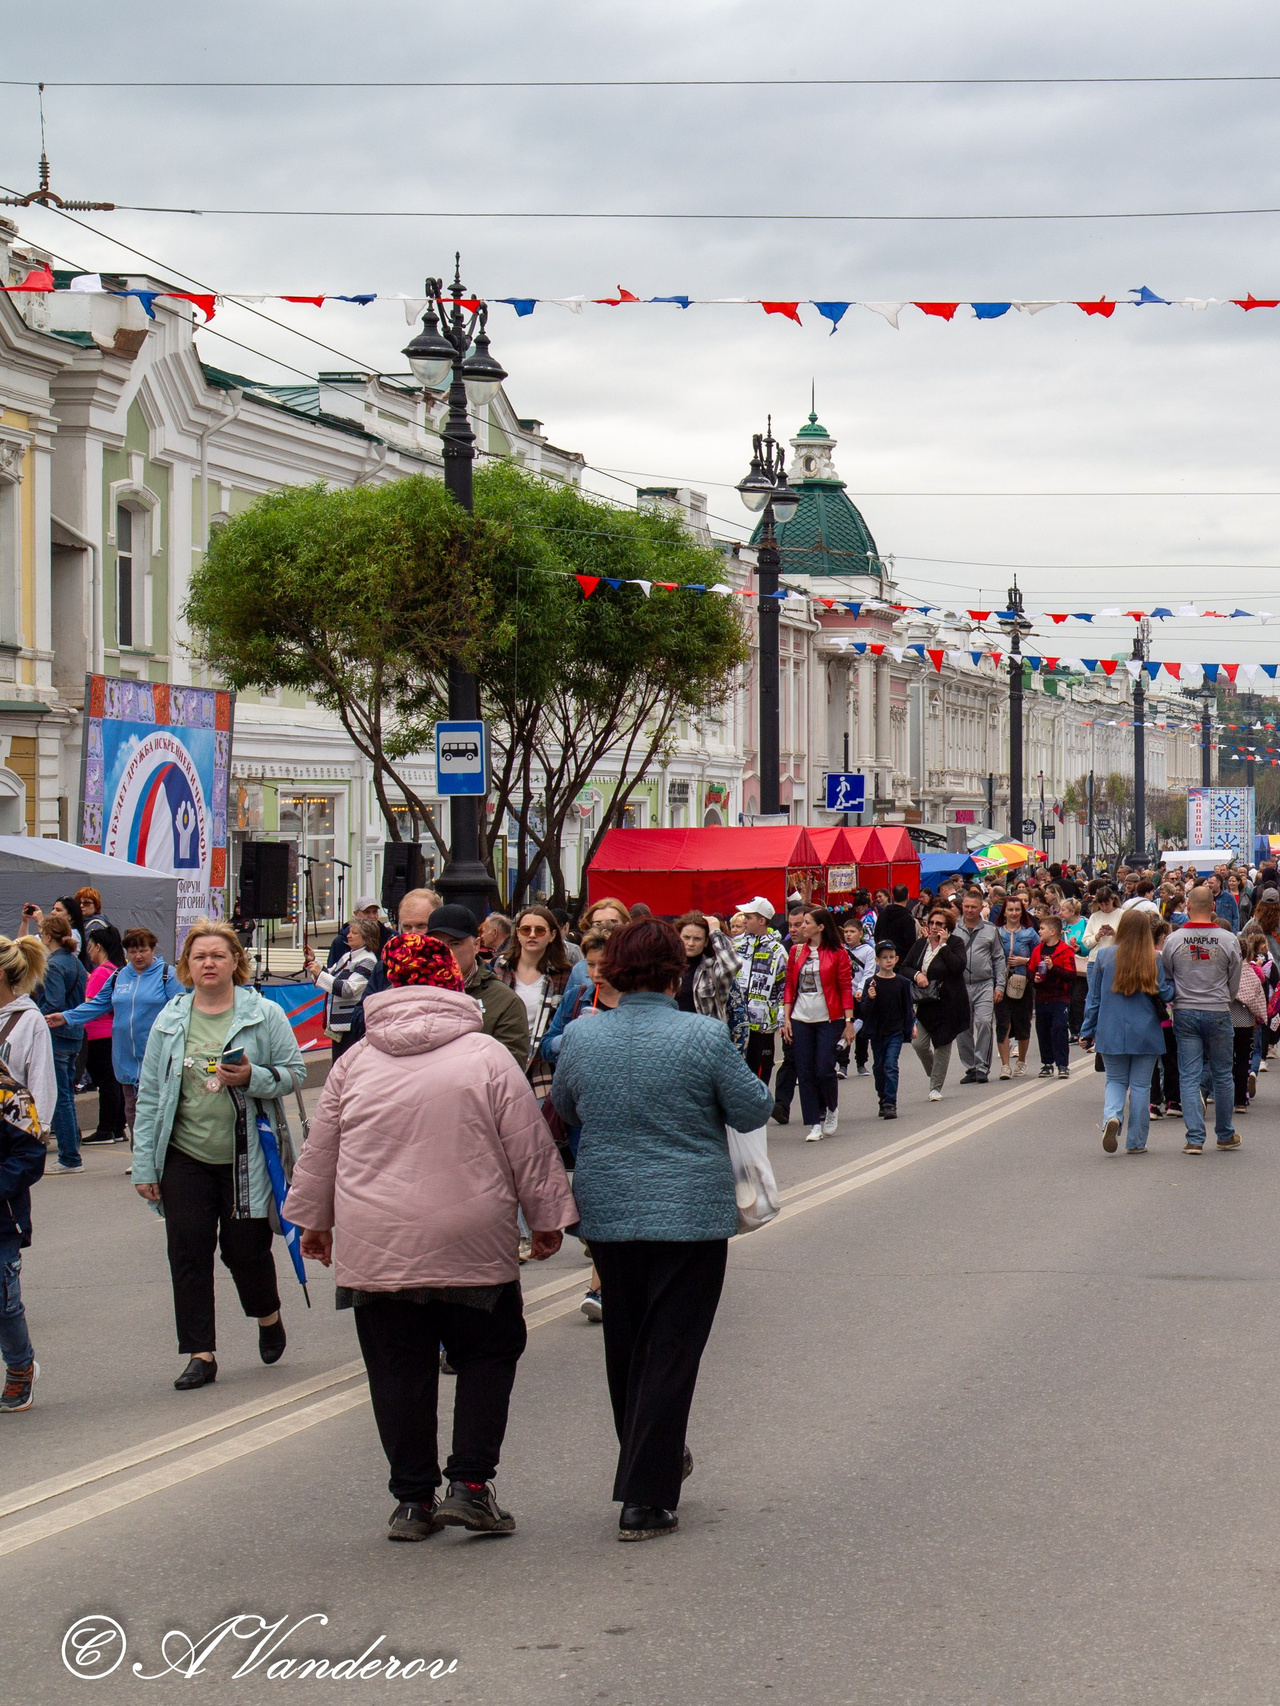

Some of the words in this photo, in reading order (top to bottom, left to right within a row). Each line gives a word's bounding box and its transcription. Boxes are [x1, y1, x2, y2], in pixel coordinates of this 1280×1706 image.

[111, 782, 127, 835] БУДЕТ
[127, 741, 154, 786] ДРУЖБА
[154, 737, 192, 775] ИСКРЕННЕЙ
[190, 773, 196, 786] И
[1194, 796, 1203, 845] ЗАПАДНЫЙ
[178, 880, 201, 894] ФОРУМ
[1183, 936, 1219, 945] NAPAPIJRI
